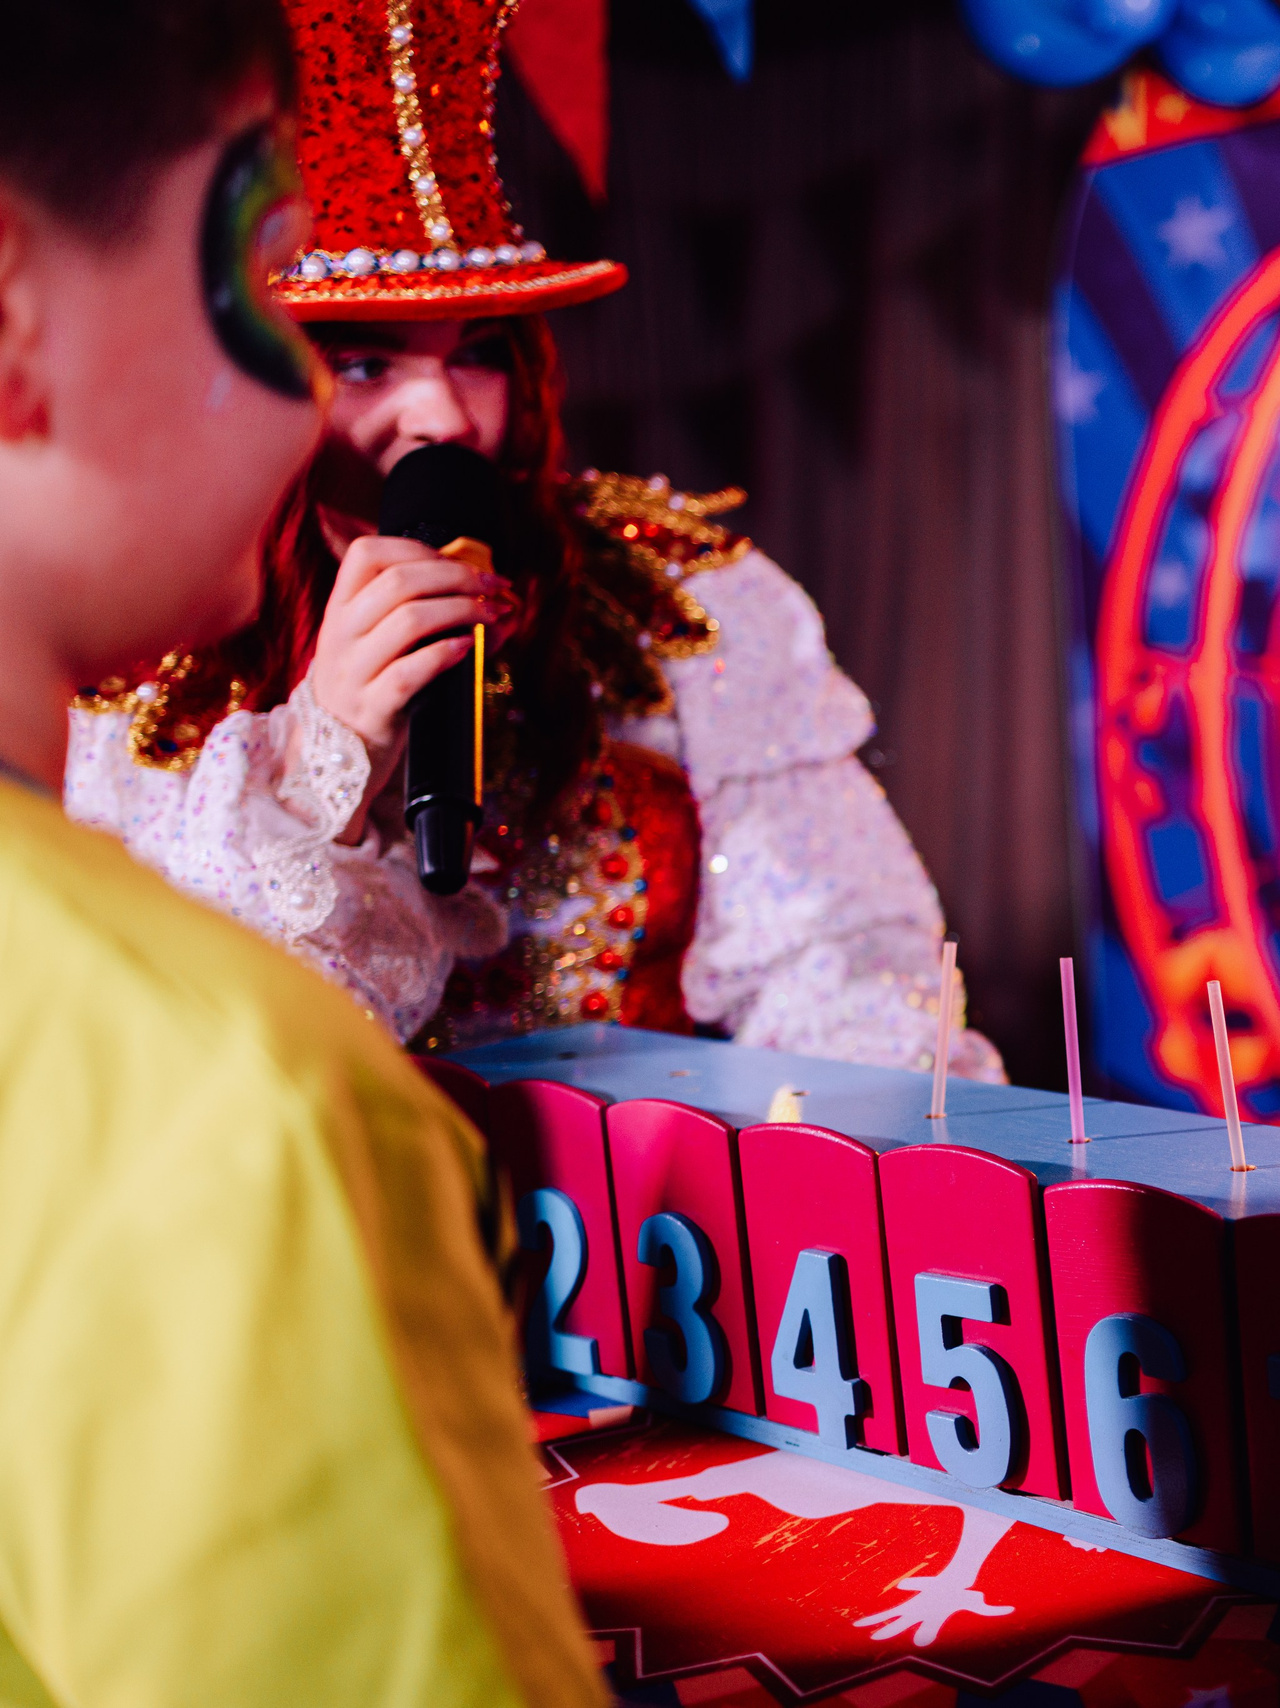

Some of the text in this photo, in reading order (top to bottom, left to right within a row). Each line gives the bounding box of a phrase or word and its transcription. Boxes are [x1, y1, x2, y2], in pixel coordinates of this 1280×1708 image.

[516, 1187, 598, 1377] 2
[637, 1212, 724, 1403] 3
[771, 1248, 864, 1450] 4
[914, 1272, 1018, 1489] 5
[1084, 1312, 1196, 1539] 6
